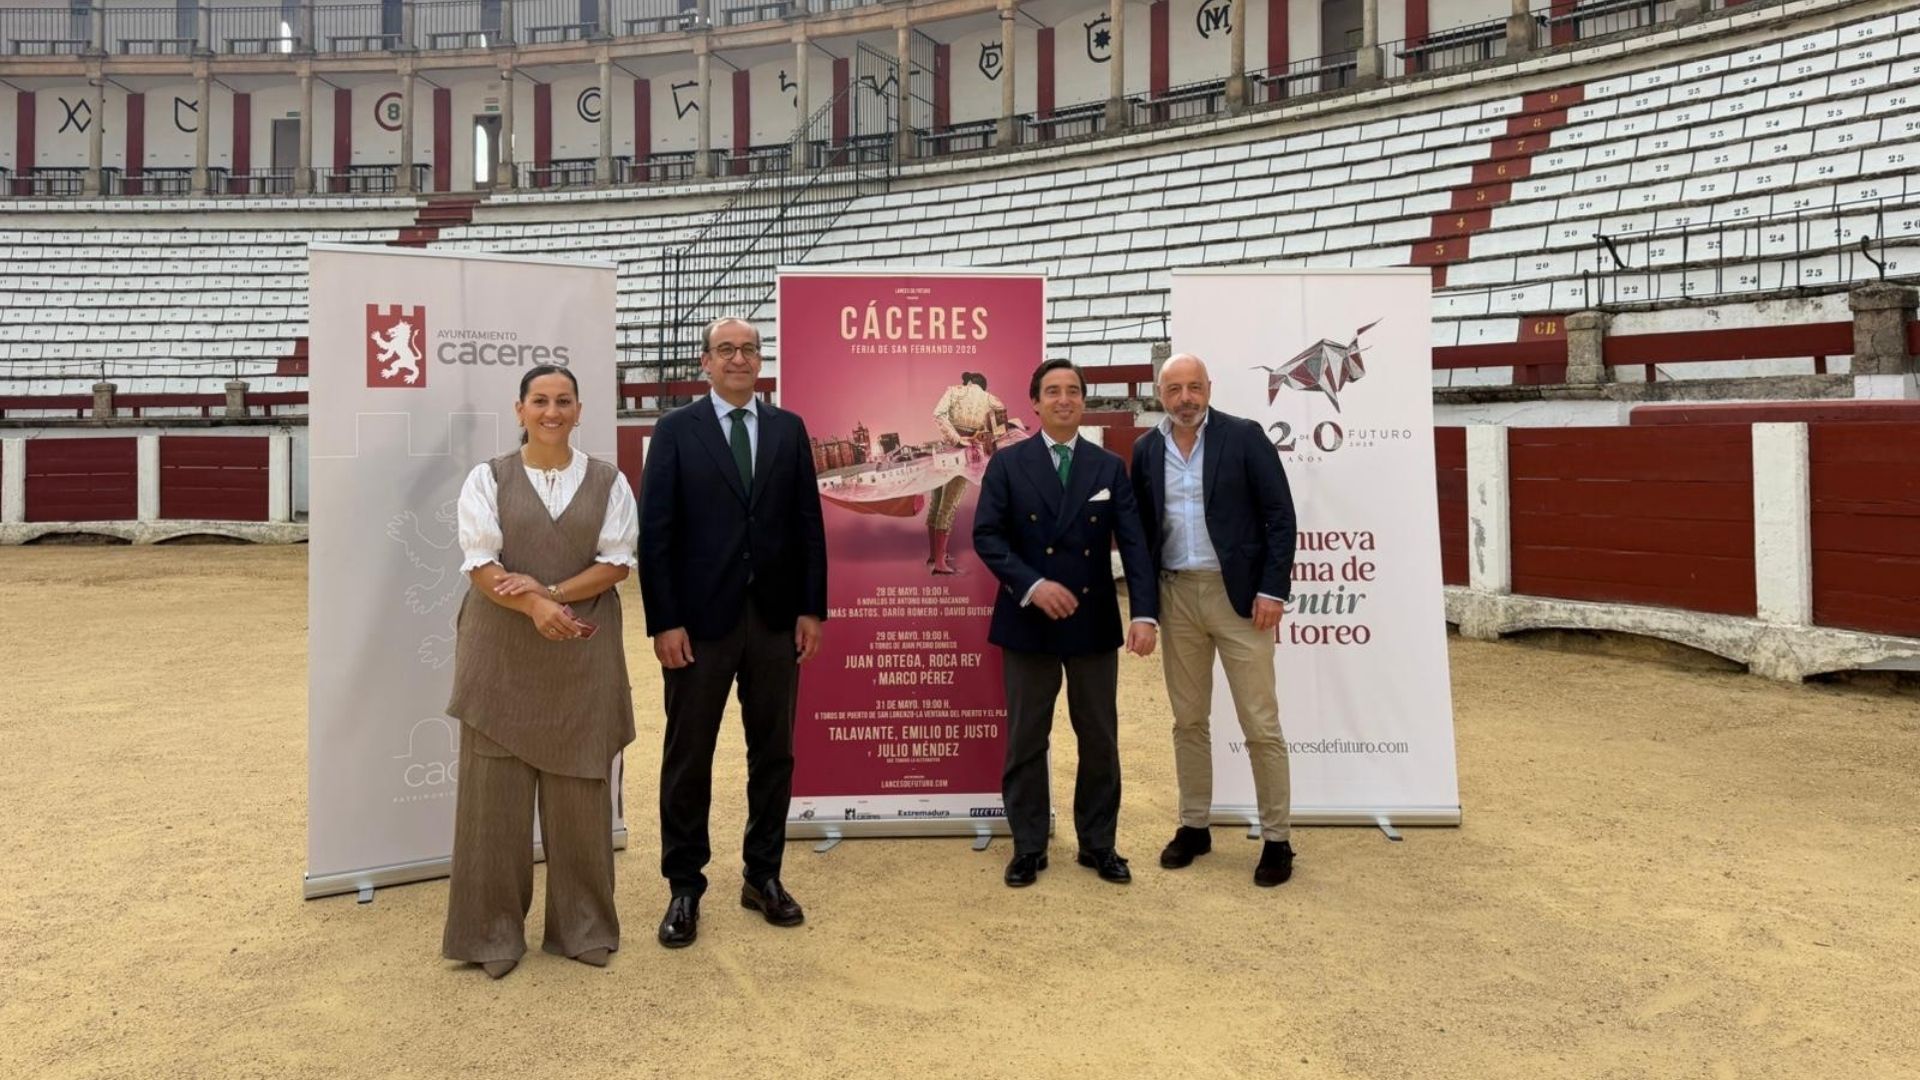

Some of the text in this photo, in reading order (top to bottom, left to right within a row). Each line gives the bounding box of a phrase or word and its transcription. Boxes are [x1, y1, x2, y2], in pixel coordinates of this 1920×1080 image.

[388, 103, 400, 120] 8
[840, 300, 988, 340] CÁCERES
[437, 330, 517, 341] AYUNTAMIENTO
[851, 345, 977, 354] FERIA DE SAN FERNANDO 2026
[1349, 429, 1412, 439] FUTURO
[1287, 455, 1322, 463] AÑOS
[1342, 556, 1375, 581] de
[887, 586, 896, 596] DE
[1283, 585, 1366, 614] entir
[907, 607, 938, 617] ROMERO
[944, 607, 966, 616] DAVID
[887, 631, 897, 640] DE
[1290, 622, 1370, 645] toreo
[845, 653, 981, 669] JUAN ORTEGA, ROCA REY
[879, 671, 917, 685] MARCO
[920, 669, 954, 685] PÉREZ
[876, 700, 885, 710] 31
[886, 700, 896, 709] DE
[828, 724, 998, 740] TALAVANTE, EMILIO DE JUSTO
[877, 741, 959, 758] JULIO MÉNDEZ
